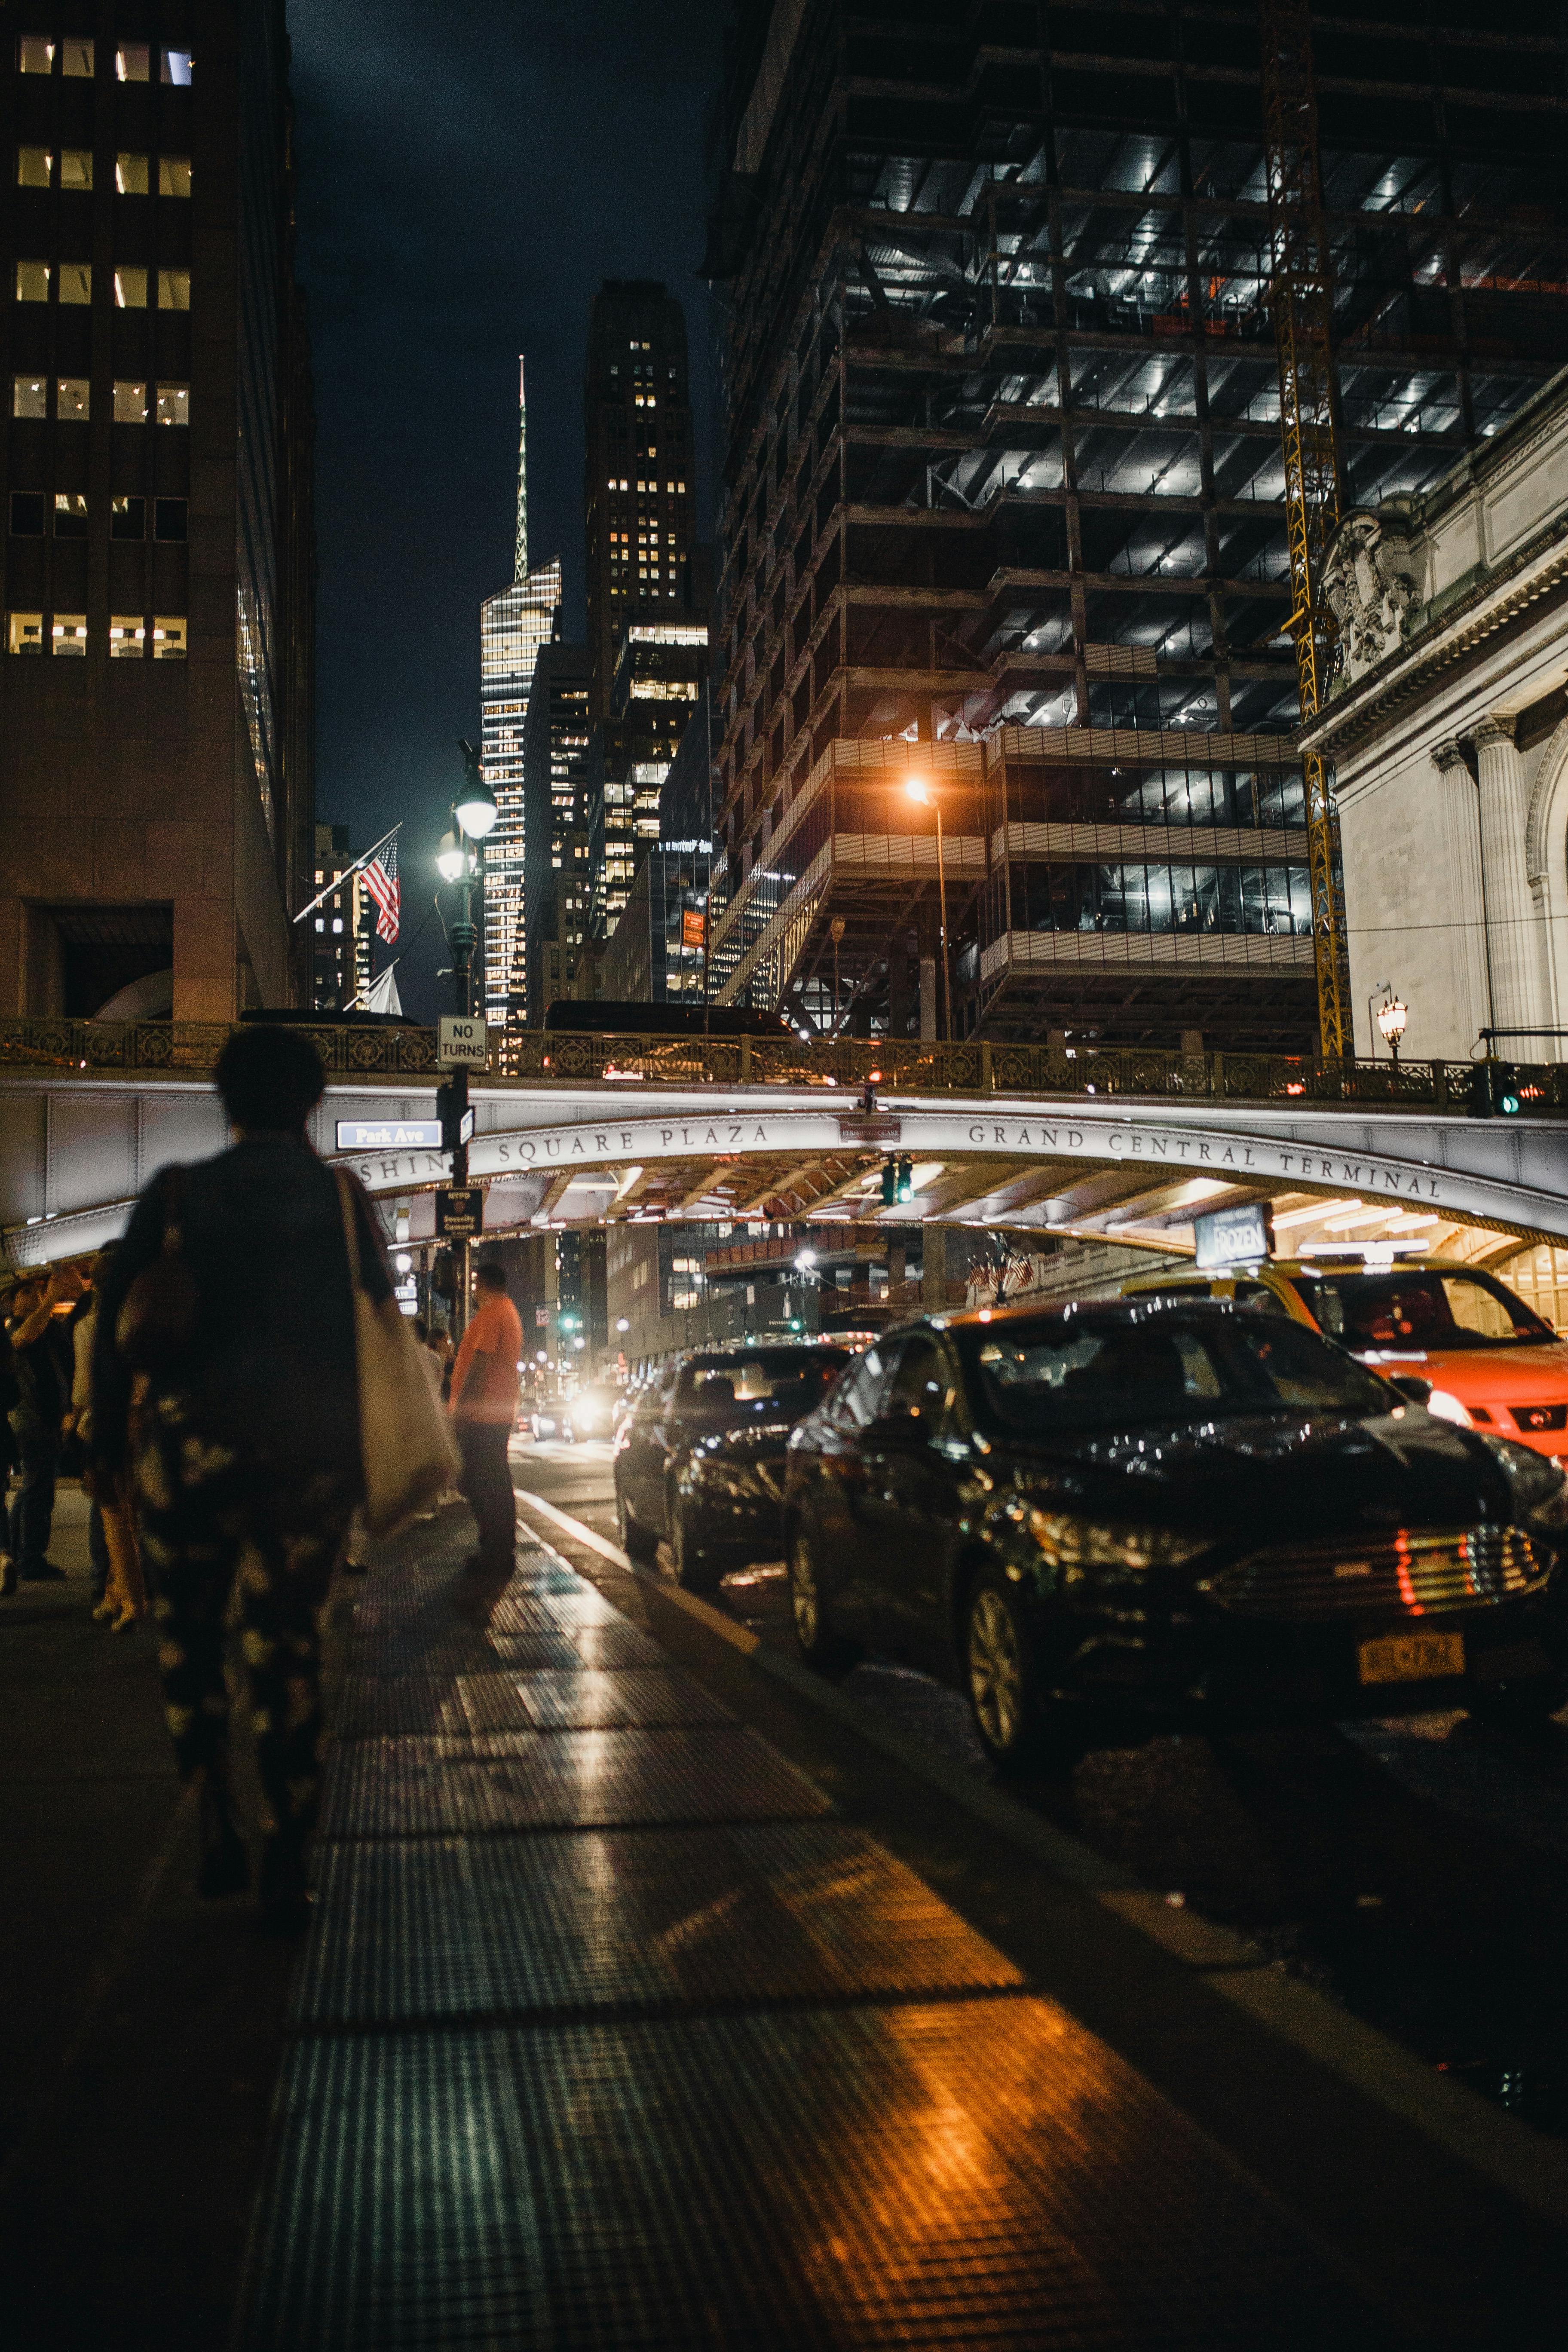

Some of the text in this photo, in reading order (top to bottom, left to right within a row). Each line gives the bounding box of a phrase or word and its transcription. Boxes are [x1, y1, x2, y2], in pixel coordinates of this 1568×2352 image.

[453, 1024, 473, 1038] NO
[442, 1043, 484, 1057] TURNS
[355, 1127, 424, 1143] Park Ave
[360, 1124, 768, 1183] SHIN SQUARE PLAZA
[968, 1125, 1440, 1197] GRAND CENTRAL TERMINAL
[1213, 1222, 1264, 1260] FROZEN
